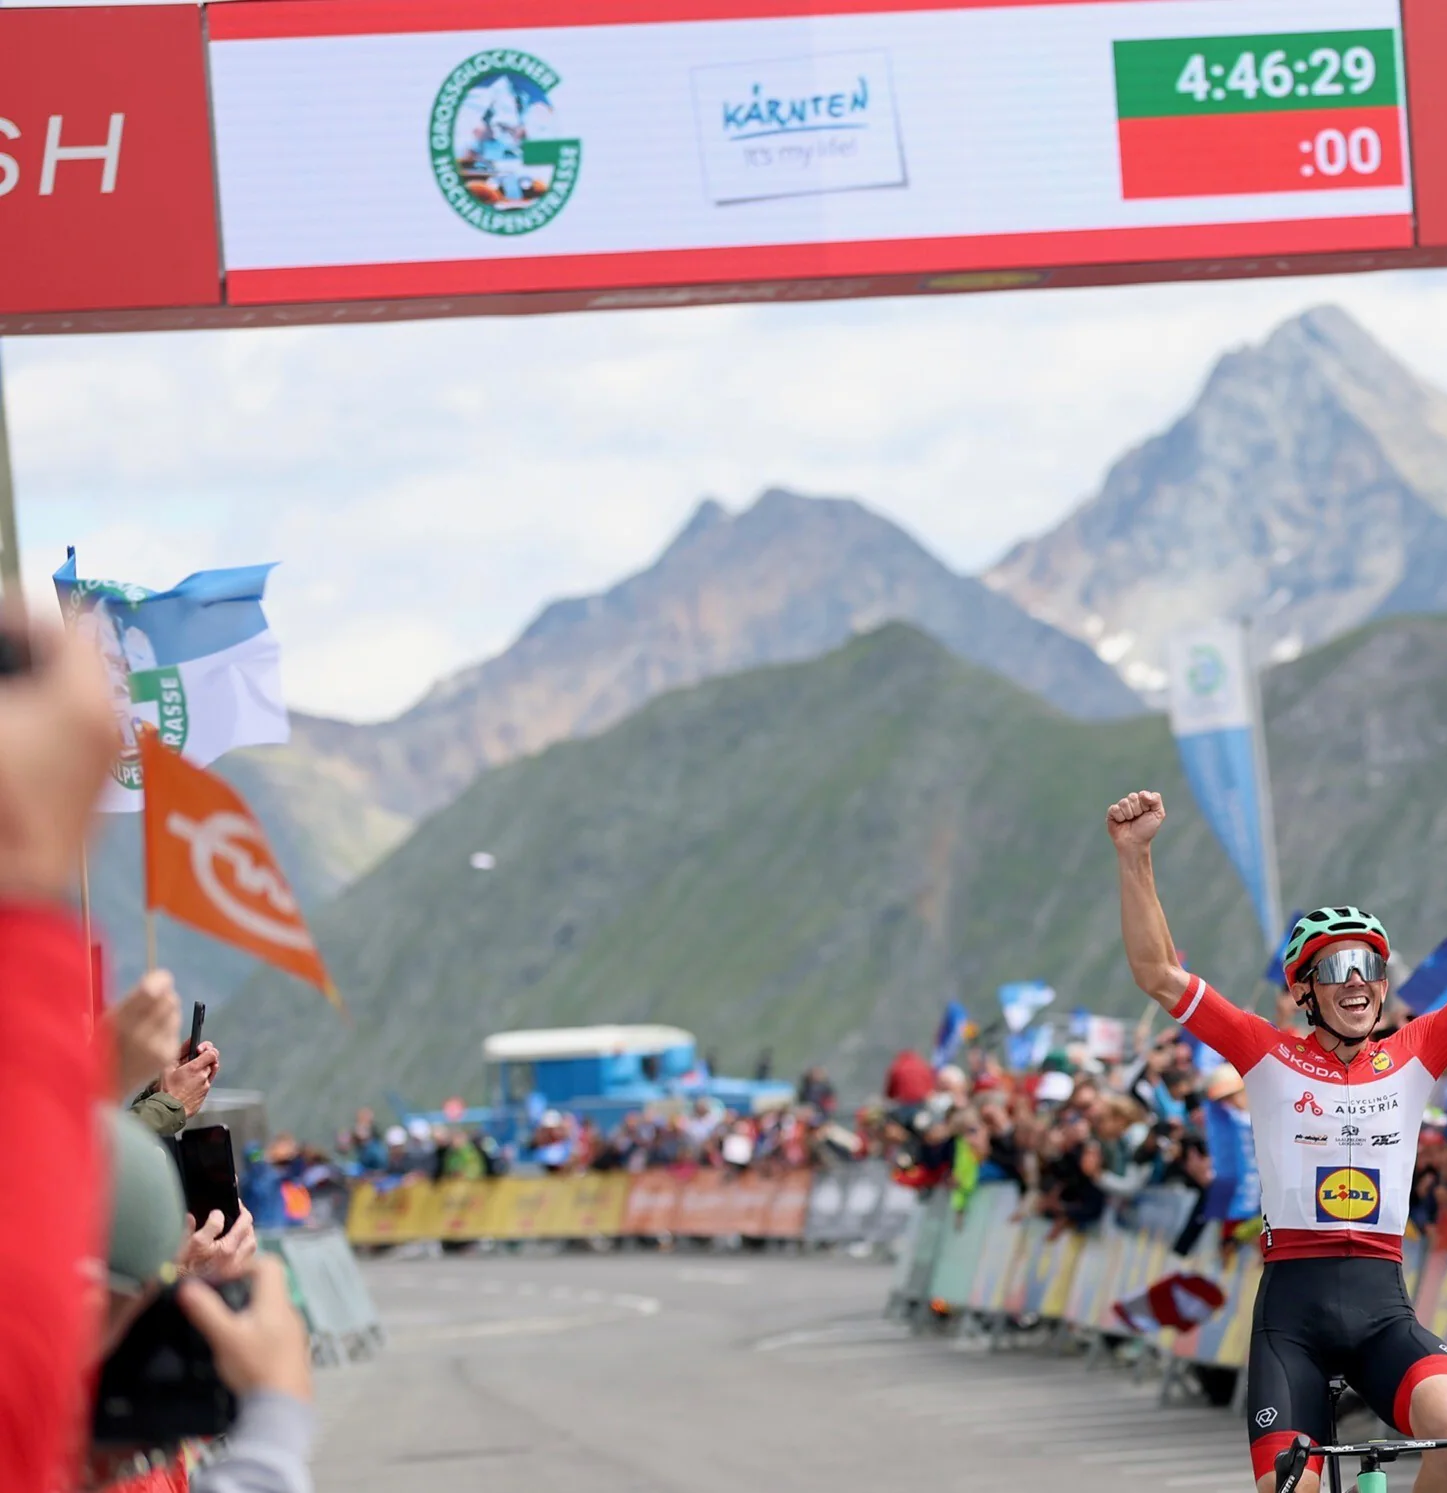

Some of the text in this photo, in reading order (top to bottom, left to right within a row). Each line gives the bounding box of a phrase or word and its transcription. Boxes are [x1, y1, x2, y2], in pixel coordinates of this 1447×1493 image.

[1175, 45, 1376, 102] 4:46:29
[432, 52, 558, 150] GROSSGLOCKNER
[1300, 126, 1382, 177] :00
[434, 145, 578, 233] HOCHALPENSTRASSE
[1278, 1042, 1343, 1081] SKODA
[1335, 1099, 1399, 1115] AUSTRIA
[1351, 1095, 1388, 1106] CYCLING
